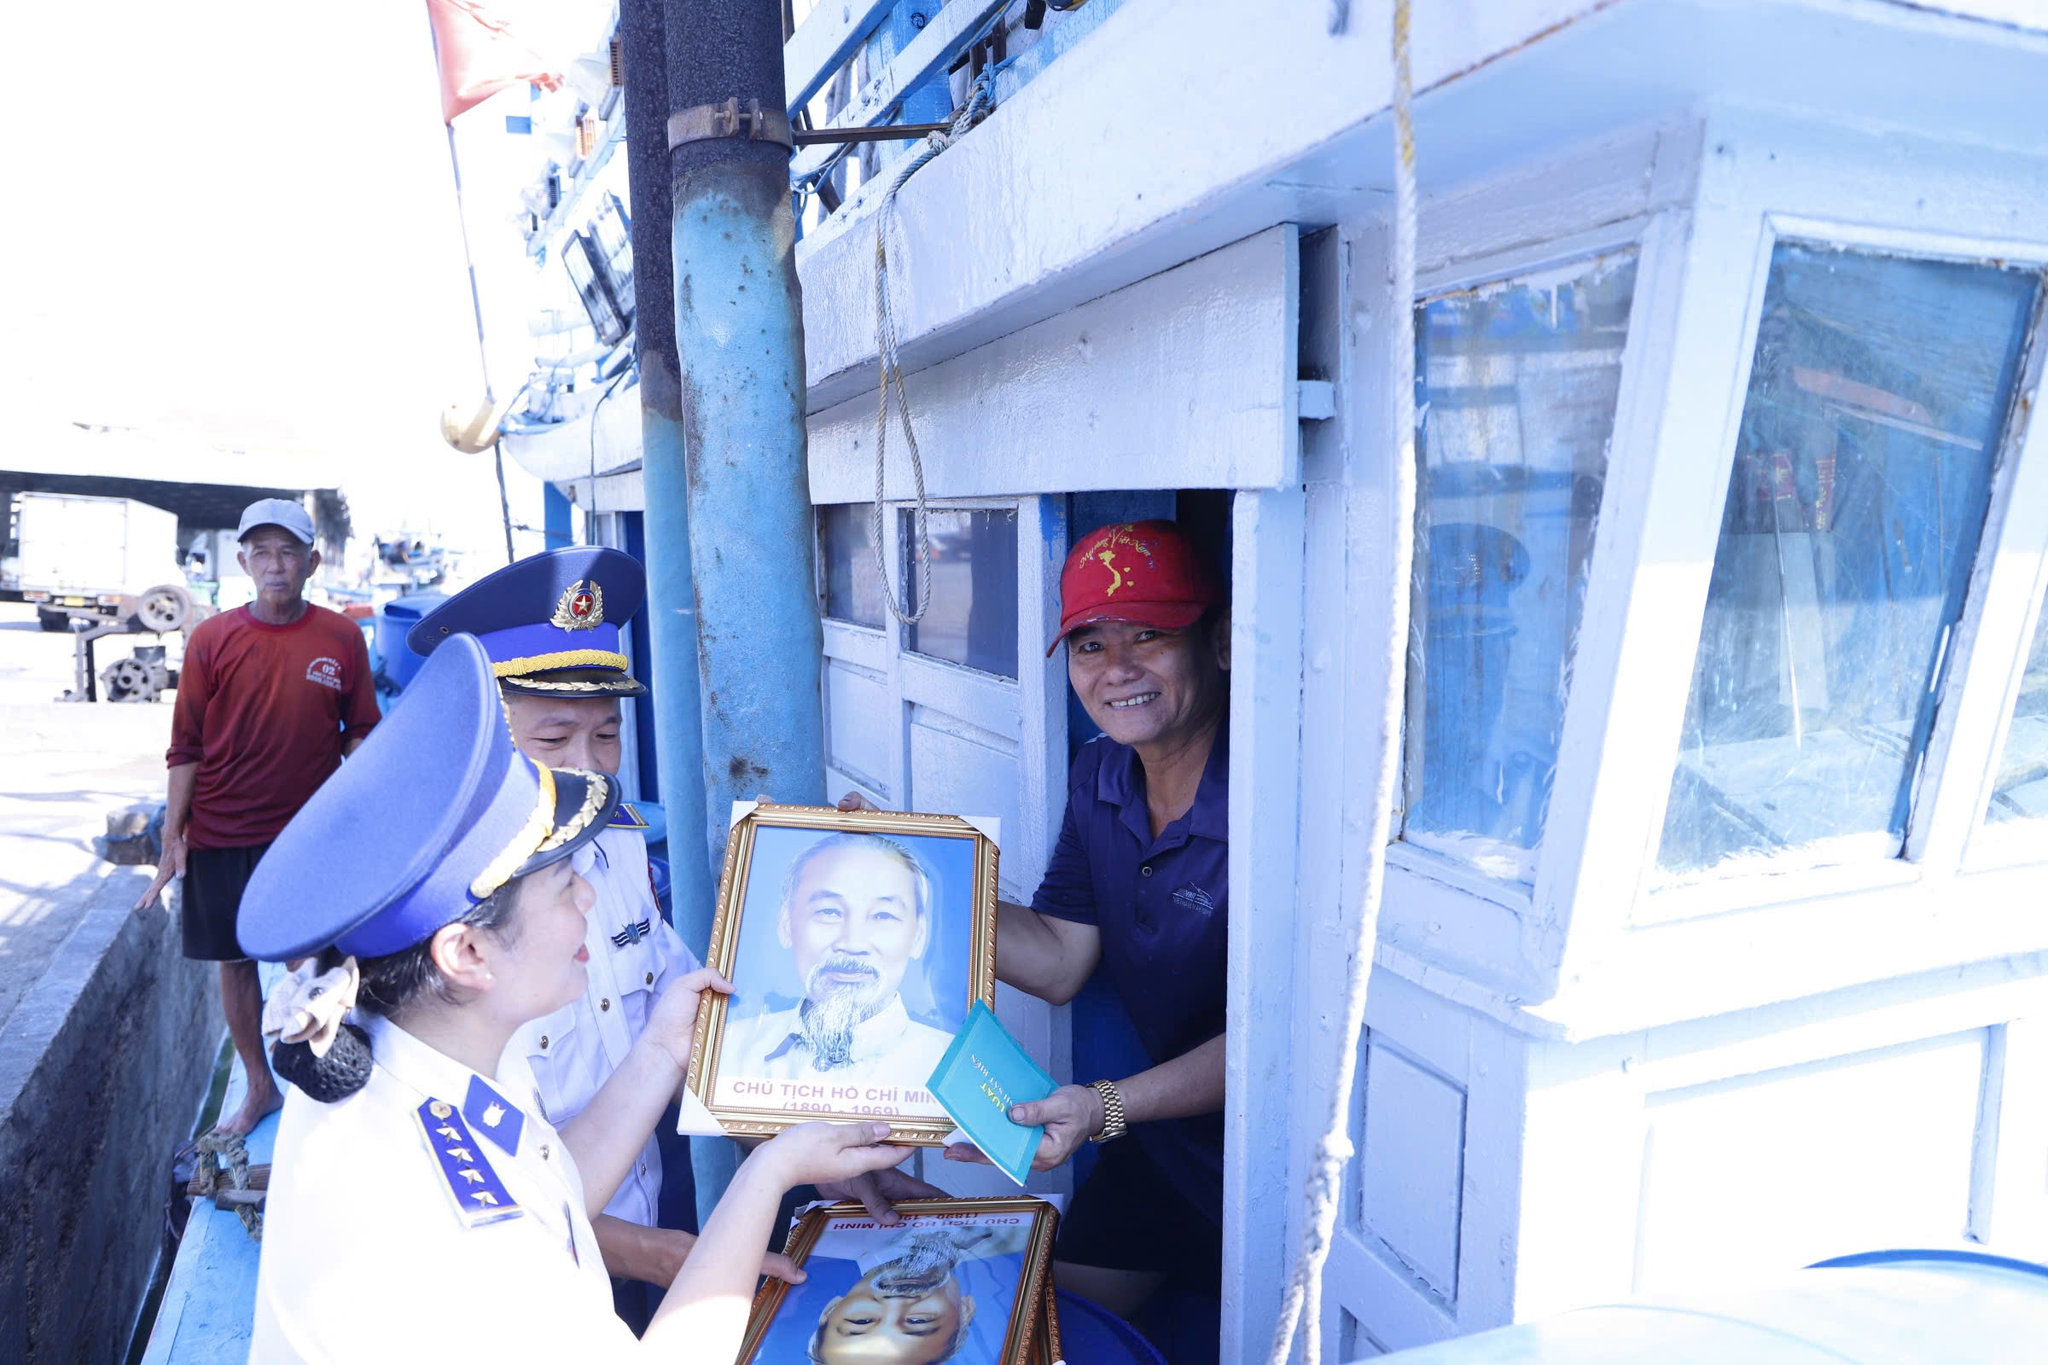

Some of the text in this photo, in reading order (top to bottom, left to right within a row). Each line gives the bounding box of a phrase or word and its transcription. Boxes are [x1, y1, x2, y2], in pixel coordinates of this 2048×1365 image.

[733, 1080, 773, 1096] CHỦ
[781, 1084, 824, 1099] TỊCH
[866, 1087, 898, 1102] CHÍ
[905, 1090, 937, 1103] MIN
[783, 1102, 832, 1113] (1890
[852, 1105, 900, 1116] 1969)
